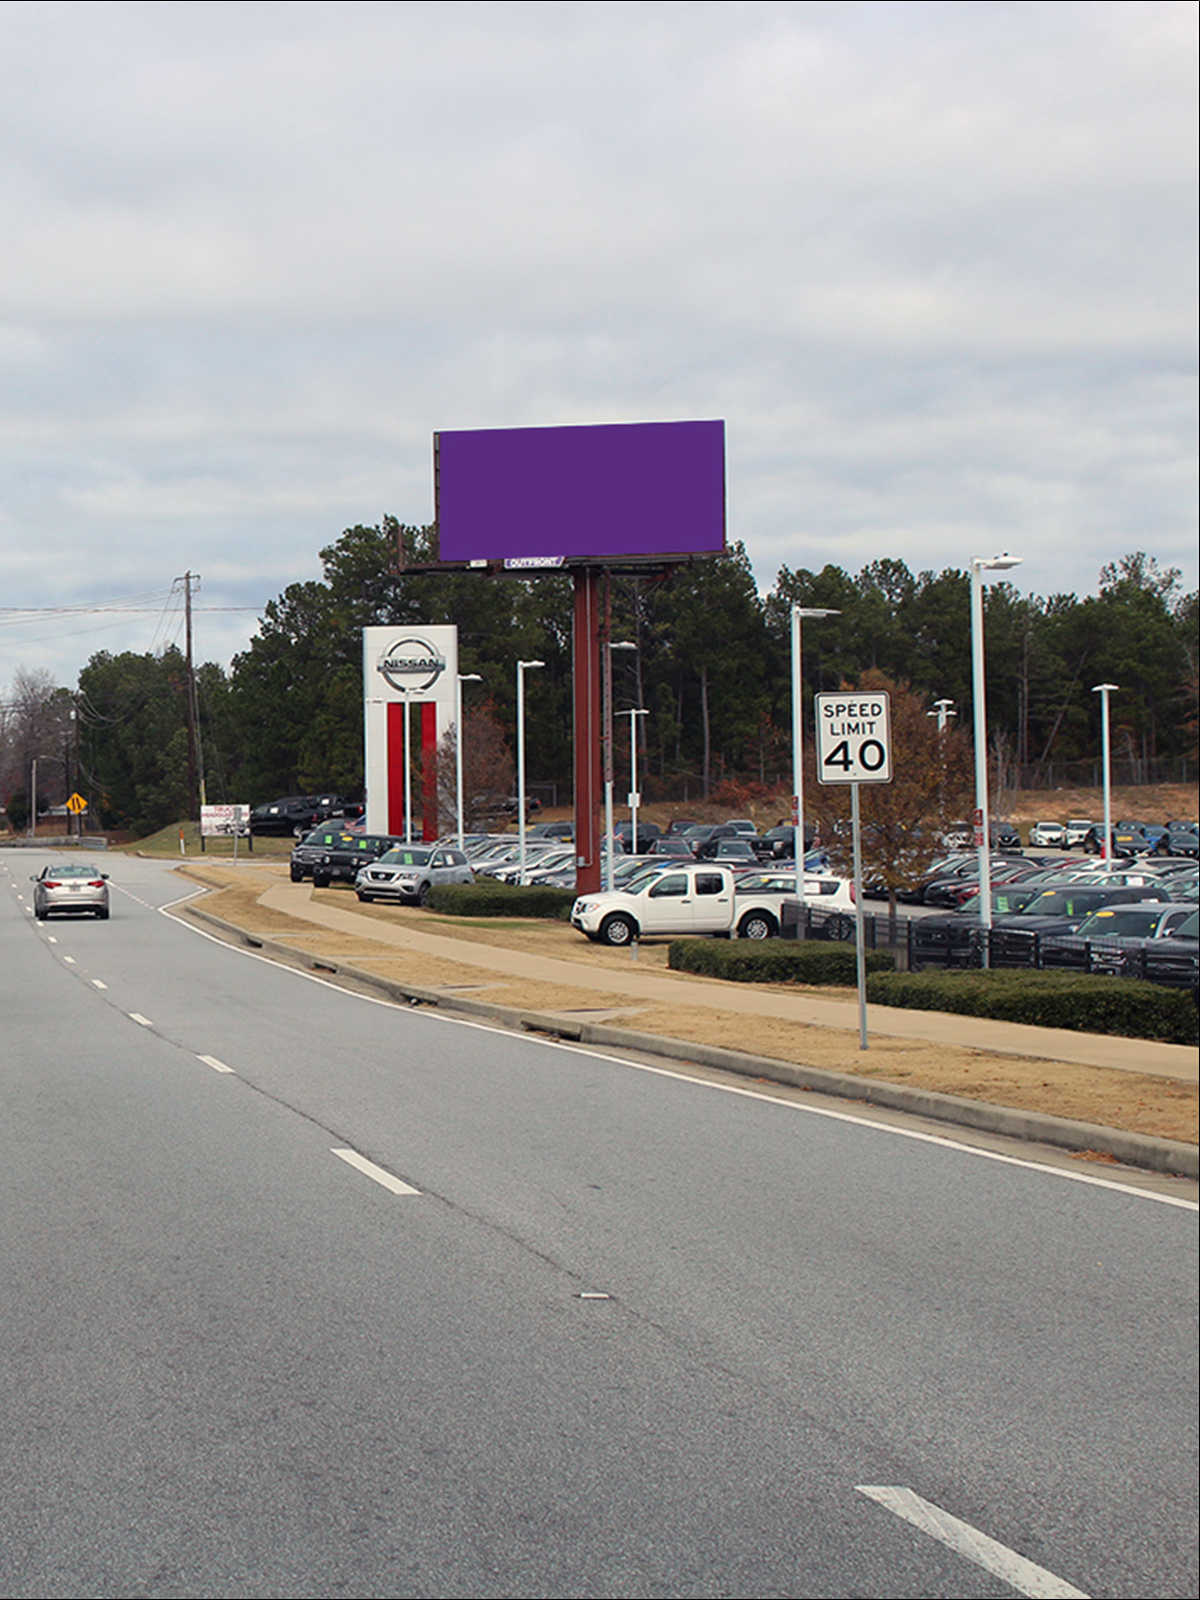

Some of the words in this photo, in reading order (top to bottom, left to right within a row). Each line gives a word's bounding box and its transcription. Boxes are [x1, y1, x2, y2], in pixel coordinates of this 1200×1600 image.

[383, 659, 439, 669] NISSAN
[823, 703, 883, 718] SPEED
[830, 721, 876, 736] LIMIT
[824, 739, 886, 772] 40
